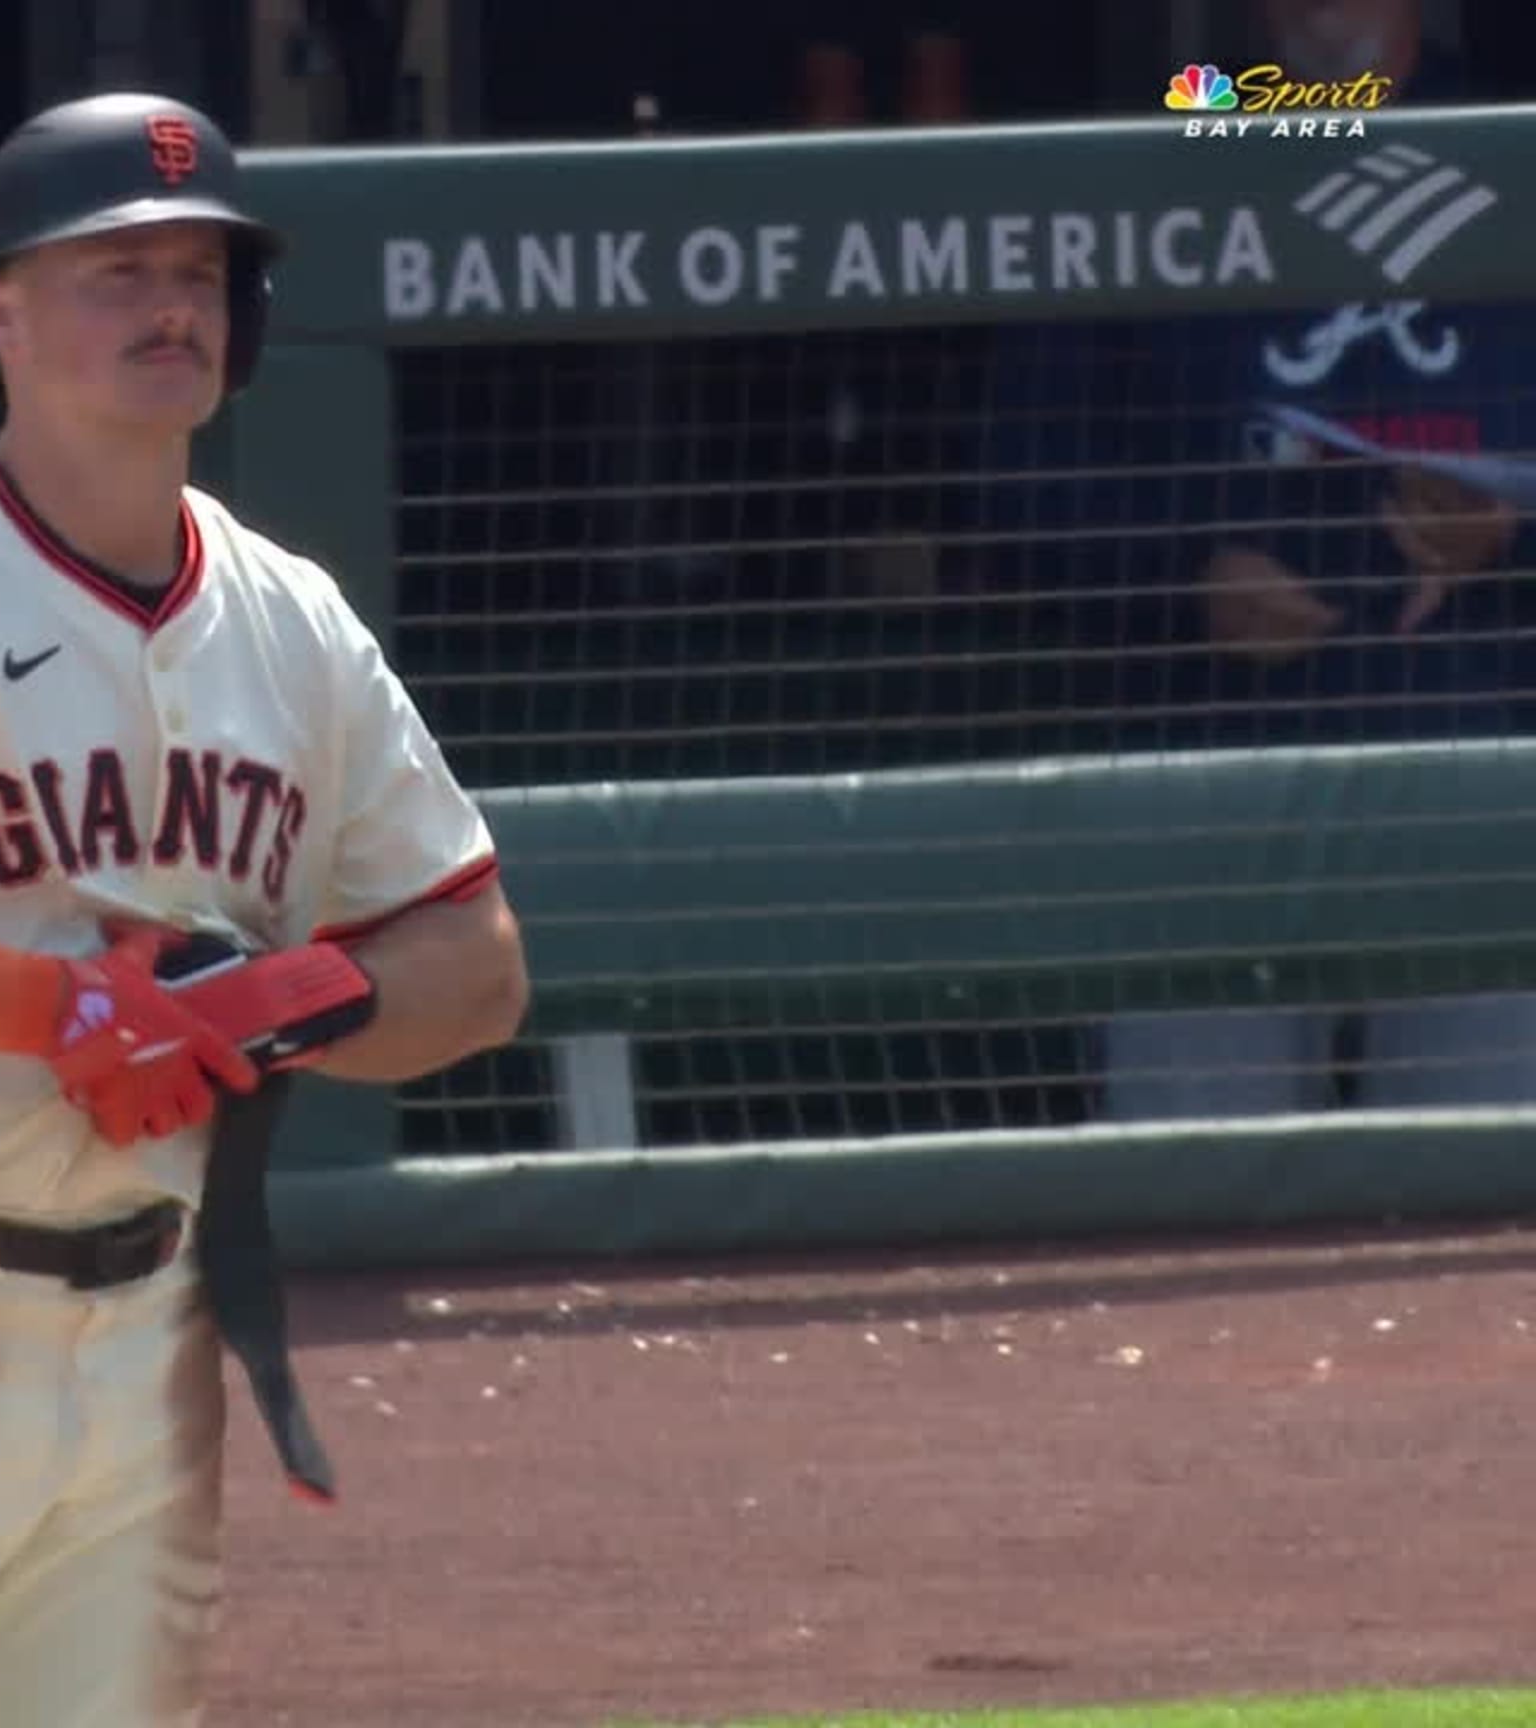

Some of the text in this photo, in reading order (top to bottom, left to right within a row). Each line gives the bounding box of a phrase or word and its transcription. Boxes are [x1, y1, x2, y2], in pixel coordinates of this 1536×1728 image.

[384, 207, 1274, 319] BANK OF AMERICA
